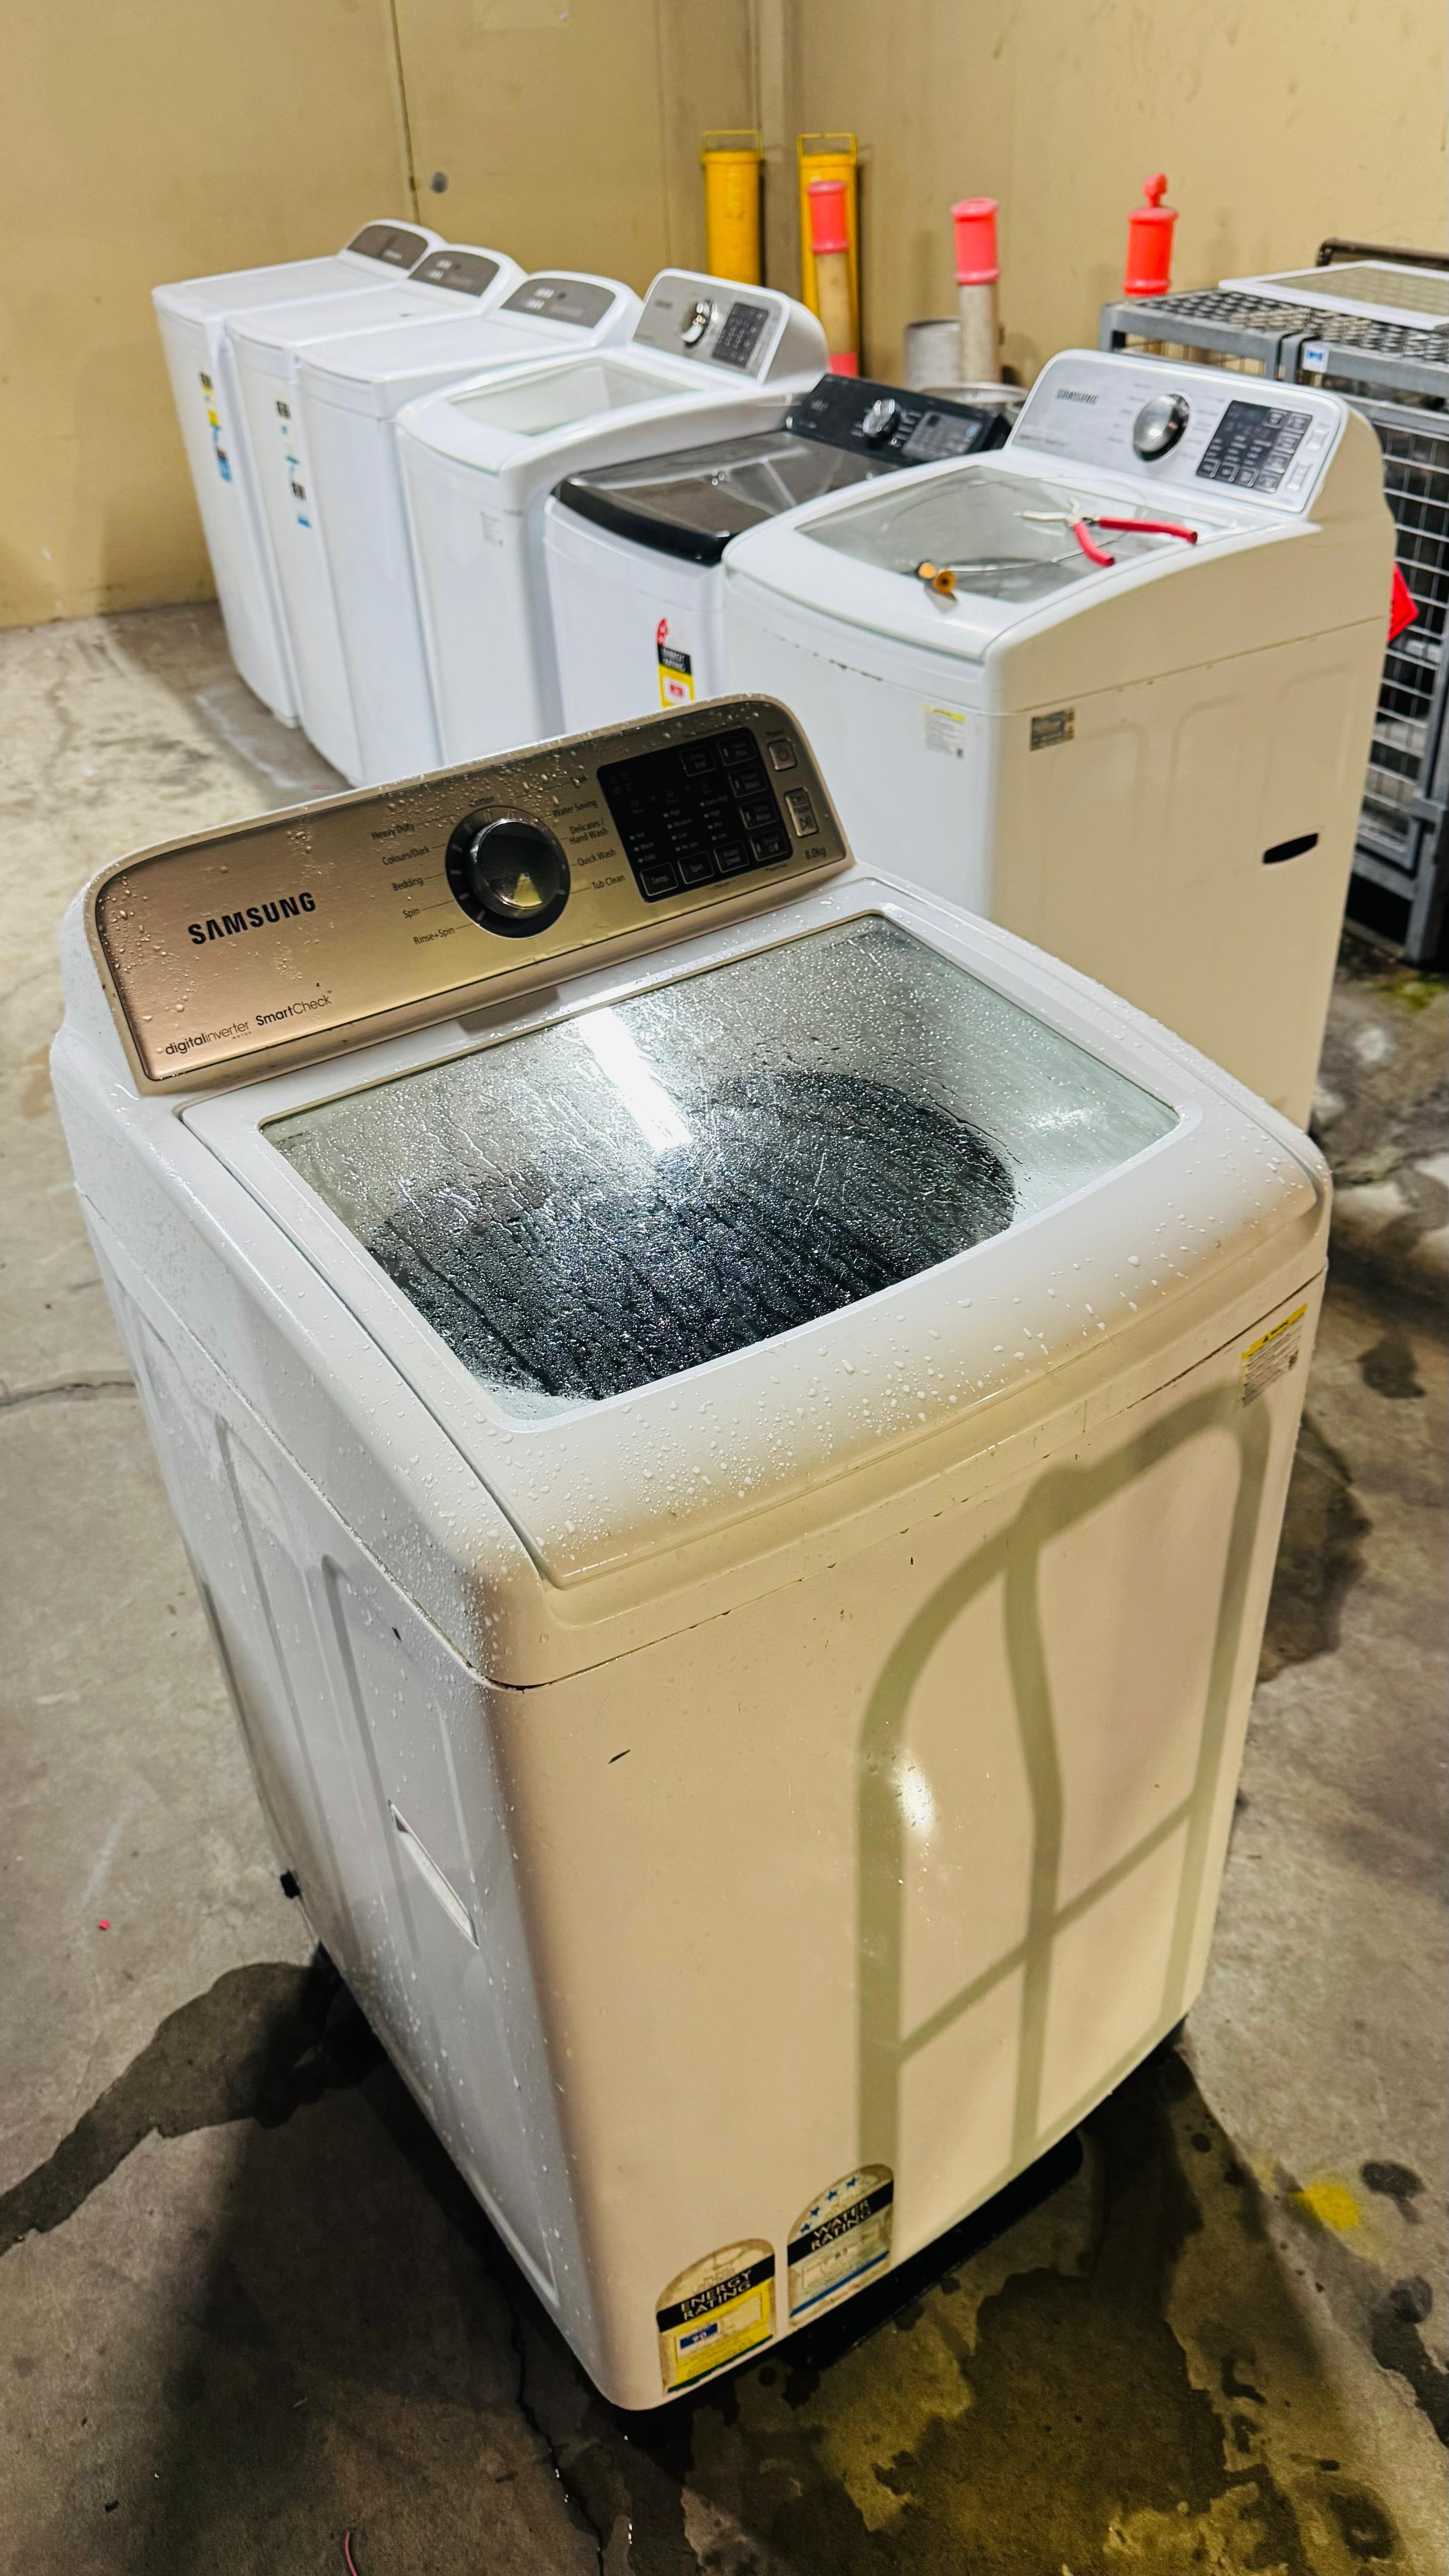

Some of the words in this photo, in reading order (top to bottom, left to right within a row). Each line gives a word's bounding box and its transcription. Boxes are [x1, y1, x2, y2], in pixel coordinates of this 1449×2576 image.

[570, 820, 601, 835] Delicates
[570, 834, 588, 845] Hand
[588, 828, 608, 839] Wash
[578, 854, 598, 866] Quick
[597, 848, 616, 860] Wash
[392, 877, 424, 891] Bedding
[592, 880, 605, 890] Tub
[605, 875, 625, 886] Clean
[188, 892, 316, 945] SAMSUNG
[403, 908, 420, 919] Spin
[413, 927, 455, 945] Rinse+Spin
[256, 995, 332, 1025] SmartCheck
[813, 2199, 870, 2237] WATER
[811, 2208, 871, 2251] RATING
[681, 2269, 752, 2312] ENERGY
[683, 2280, 751, 2321] RATING
